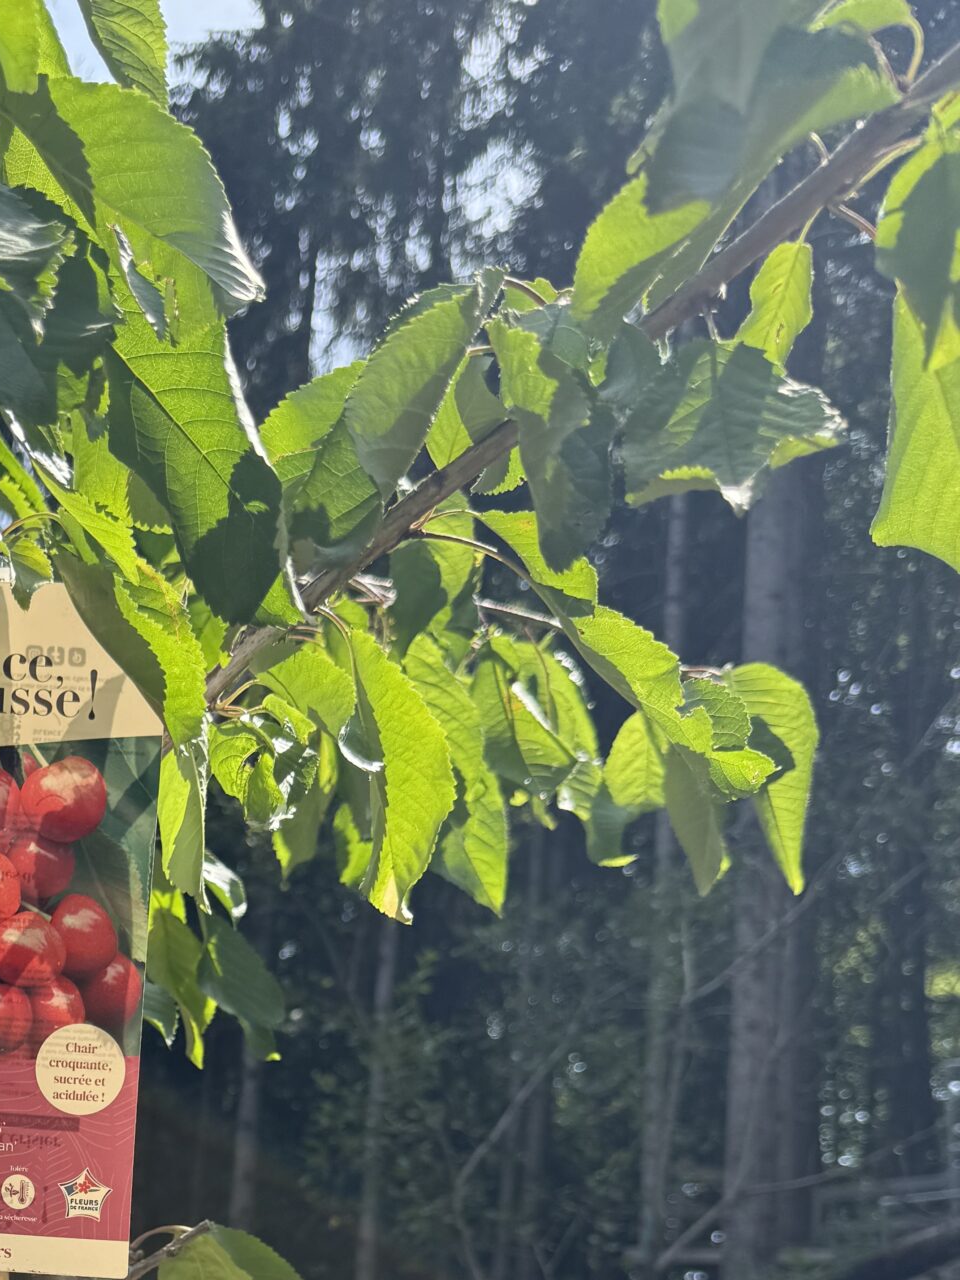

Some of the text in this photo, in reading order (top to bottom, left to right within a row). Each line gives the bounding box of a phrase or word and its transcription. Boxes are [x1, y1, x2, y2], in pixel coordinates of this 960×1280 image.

[65, 1042, 98, 1054] Chair
[48, 1057, 112, 1072] croquante,
[52, 1073, 106, 1087] sucrée et
[52, 1089, 99, 1102] acidulée
[4, 1214, 37, 1222] sécheresse
